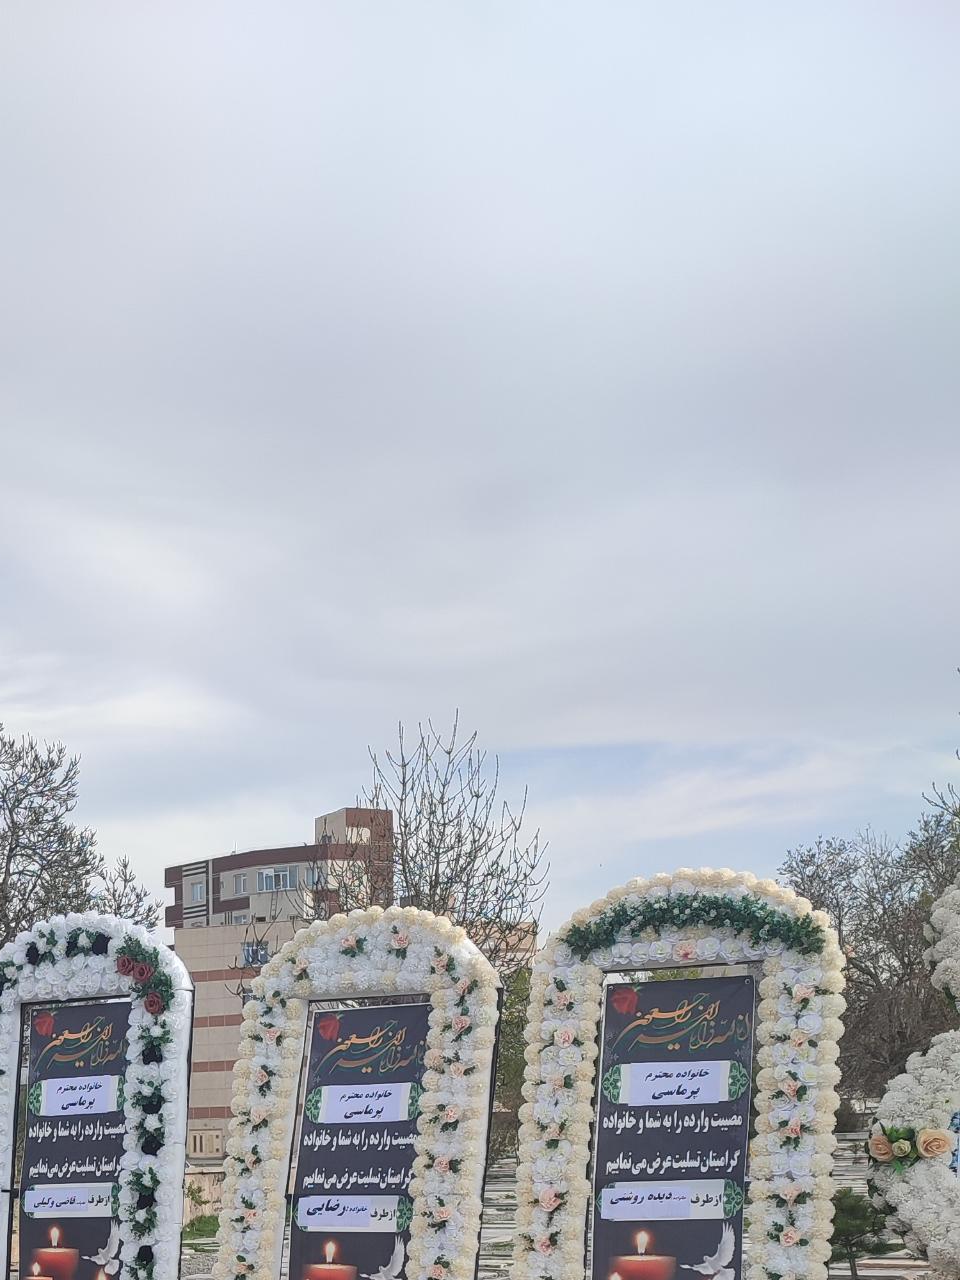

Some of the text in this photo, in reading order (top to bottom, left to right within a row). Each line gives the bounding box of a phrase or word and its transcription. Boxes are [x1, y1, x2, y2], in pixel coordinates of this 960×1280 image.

[645, 1069, 710, 1081] خانواده محترم
[57, 1082, 102, 1093] خانواده محترم
[340, 1090, 392, 1102] خانواده محترم
[29, 1121, 52, 1142] خانواده
[58, 1121, 69, 1136] شما
[79, 1120, 84, 1141] را
[85, 1120, 102, 1140] وارده
[603, 1109, 742, 1134] مصیبت وارده را به شما و خانواده
[52, 1128, 57, 1142] و
[71, 1125, 77, 1140] به
[304, 1129, 331, 1151] خانواده
[338, 1129, 352, 1146] شما
[352, 1133, 359, 1150] به
[362, 1129, 368, 1151] را
[370, 1129, 390, 1150] وارده
[331, 1136, 336, 1151] و
[59, 1158, 76, 1178] عرض
[77, 1156, 96, 1176] تسلیت
[647, 1152, 672, 1174] عرض
[673, 1151, 700, 1172] تسلیت
[701, 1150, 740, 1172] گرامیتان
[337, 1169, 357, 1189] عرض
[357, 1168, 382, 1188] تسلیت
[307, 1198, 346, 1216] رضایی
